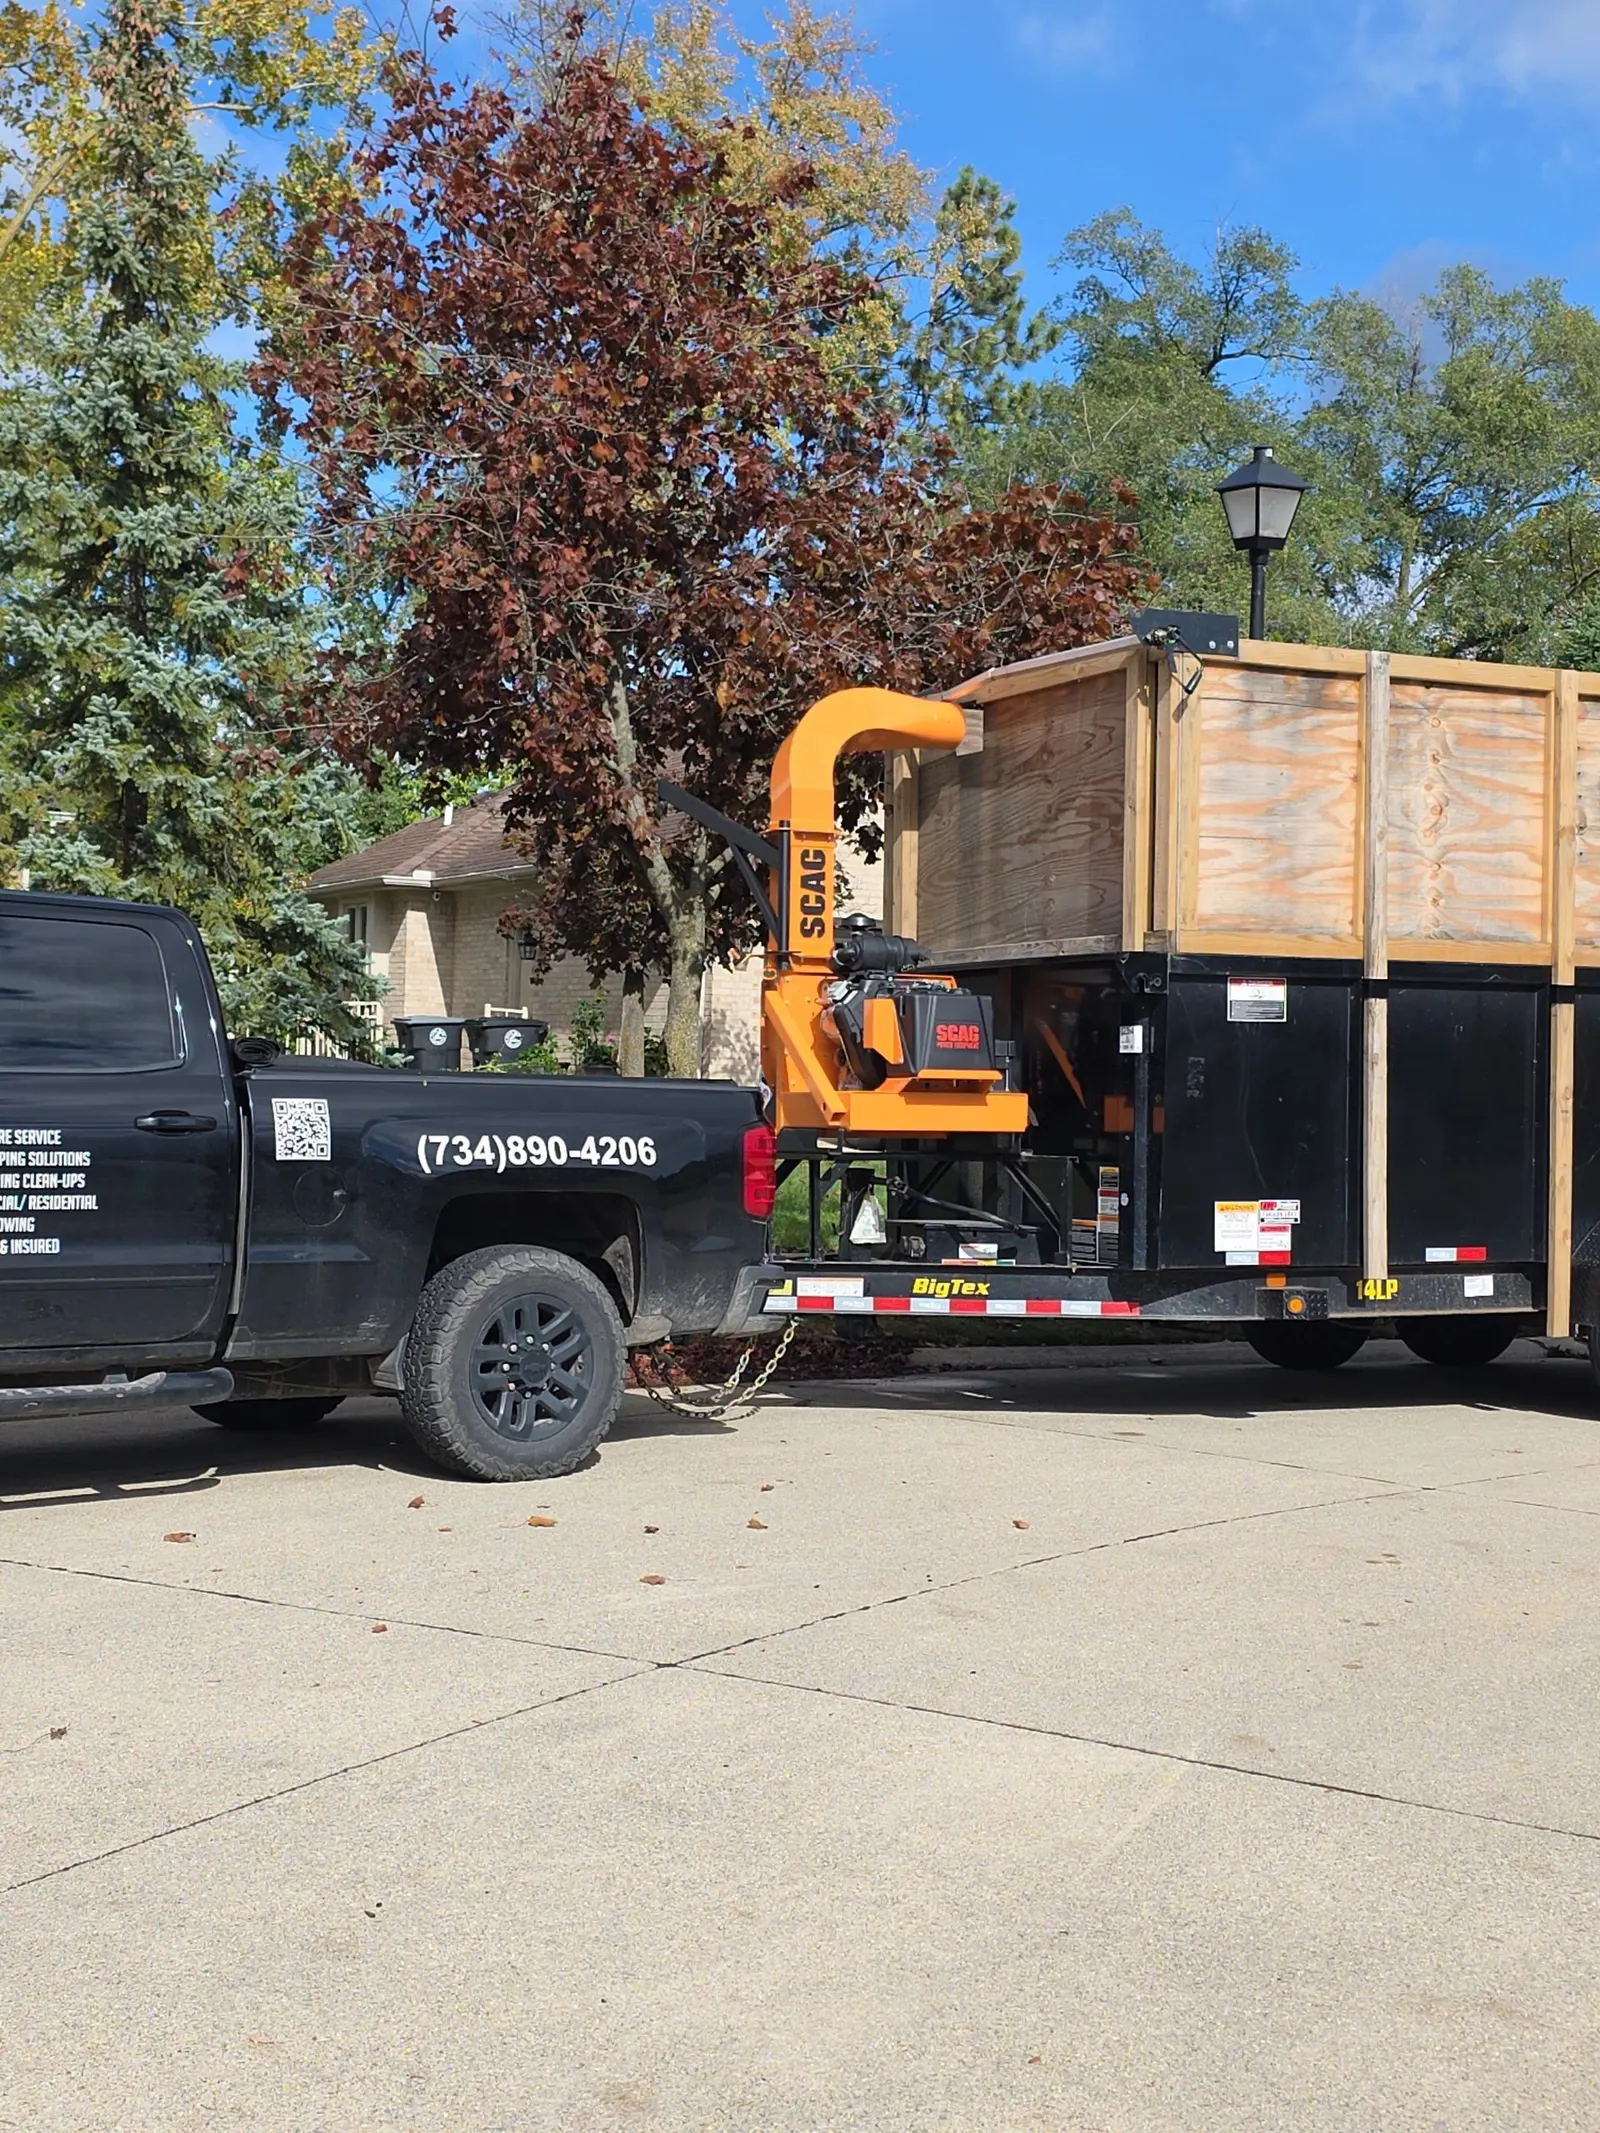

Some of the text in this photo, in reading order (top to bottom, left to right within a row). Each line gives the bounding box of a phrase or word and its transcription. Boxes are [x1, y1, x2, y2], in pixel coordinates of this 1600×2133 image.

[800, 849, 826, 938] SCAG
[936, 1024, 980, 1042] SCAG
[14, 1129, 62, 1145] SERVICE
[28, 1151, 91, 1166] SOLUTIONS
[417, 1134, 657, 1174] (734)890-4206
[22, 1173, 86, 1188] CLEAN-UPS
[28, 1195, 99, 1210] RESIDENTIAL
[10, 1238, 60, 1254] INSURED
[912, 1278, 991, 1298] BigTex
[1356, 1278, 1399, 1300] 14LP
